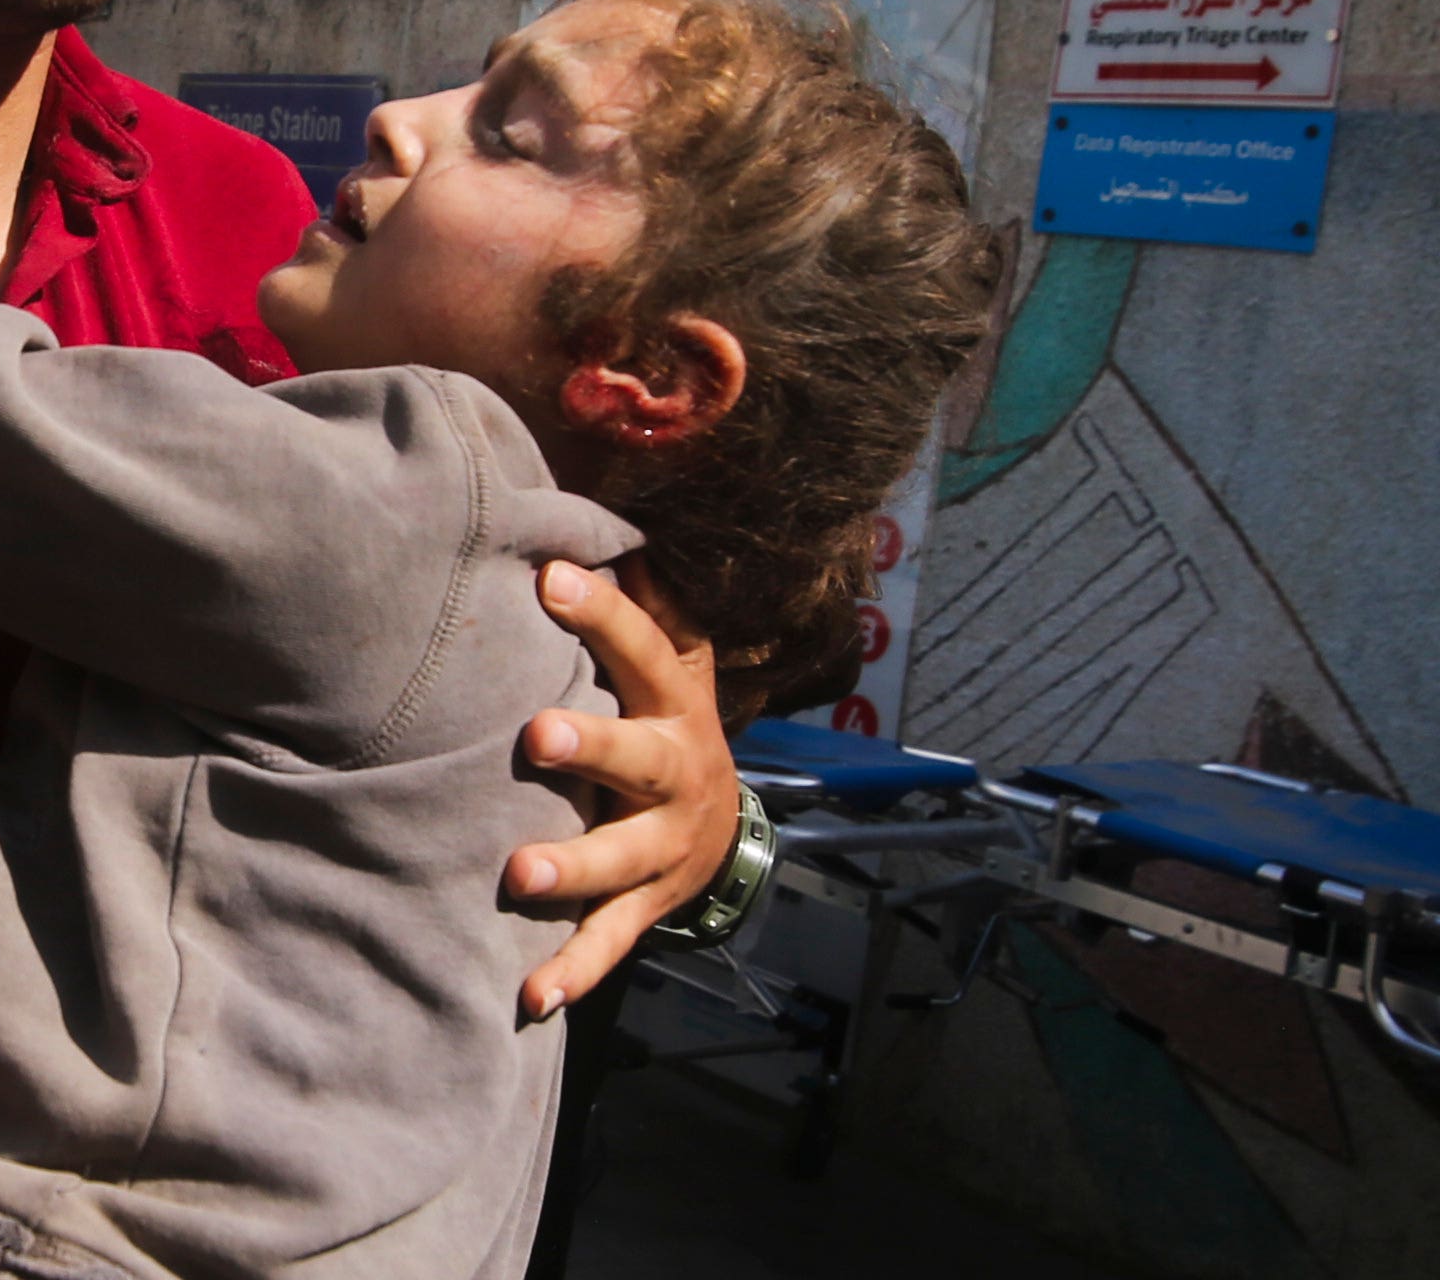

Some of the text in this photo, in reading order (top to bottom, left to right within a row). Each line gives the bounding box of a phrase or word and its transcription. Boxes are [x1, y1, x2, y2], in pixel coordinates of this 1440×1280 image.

[1085, 23, 1309, 49] Respiratory Triage Center
[270, 105, 342, 143] Station
[1073, 132, 1296, 161] Data Registration Office
[1181, 179, 1250, 209] مكتب
[874, 524, 893, 564] 2
